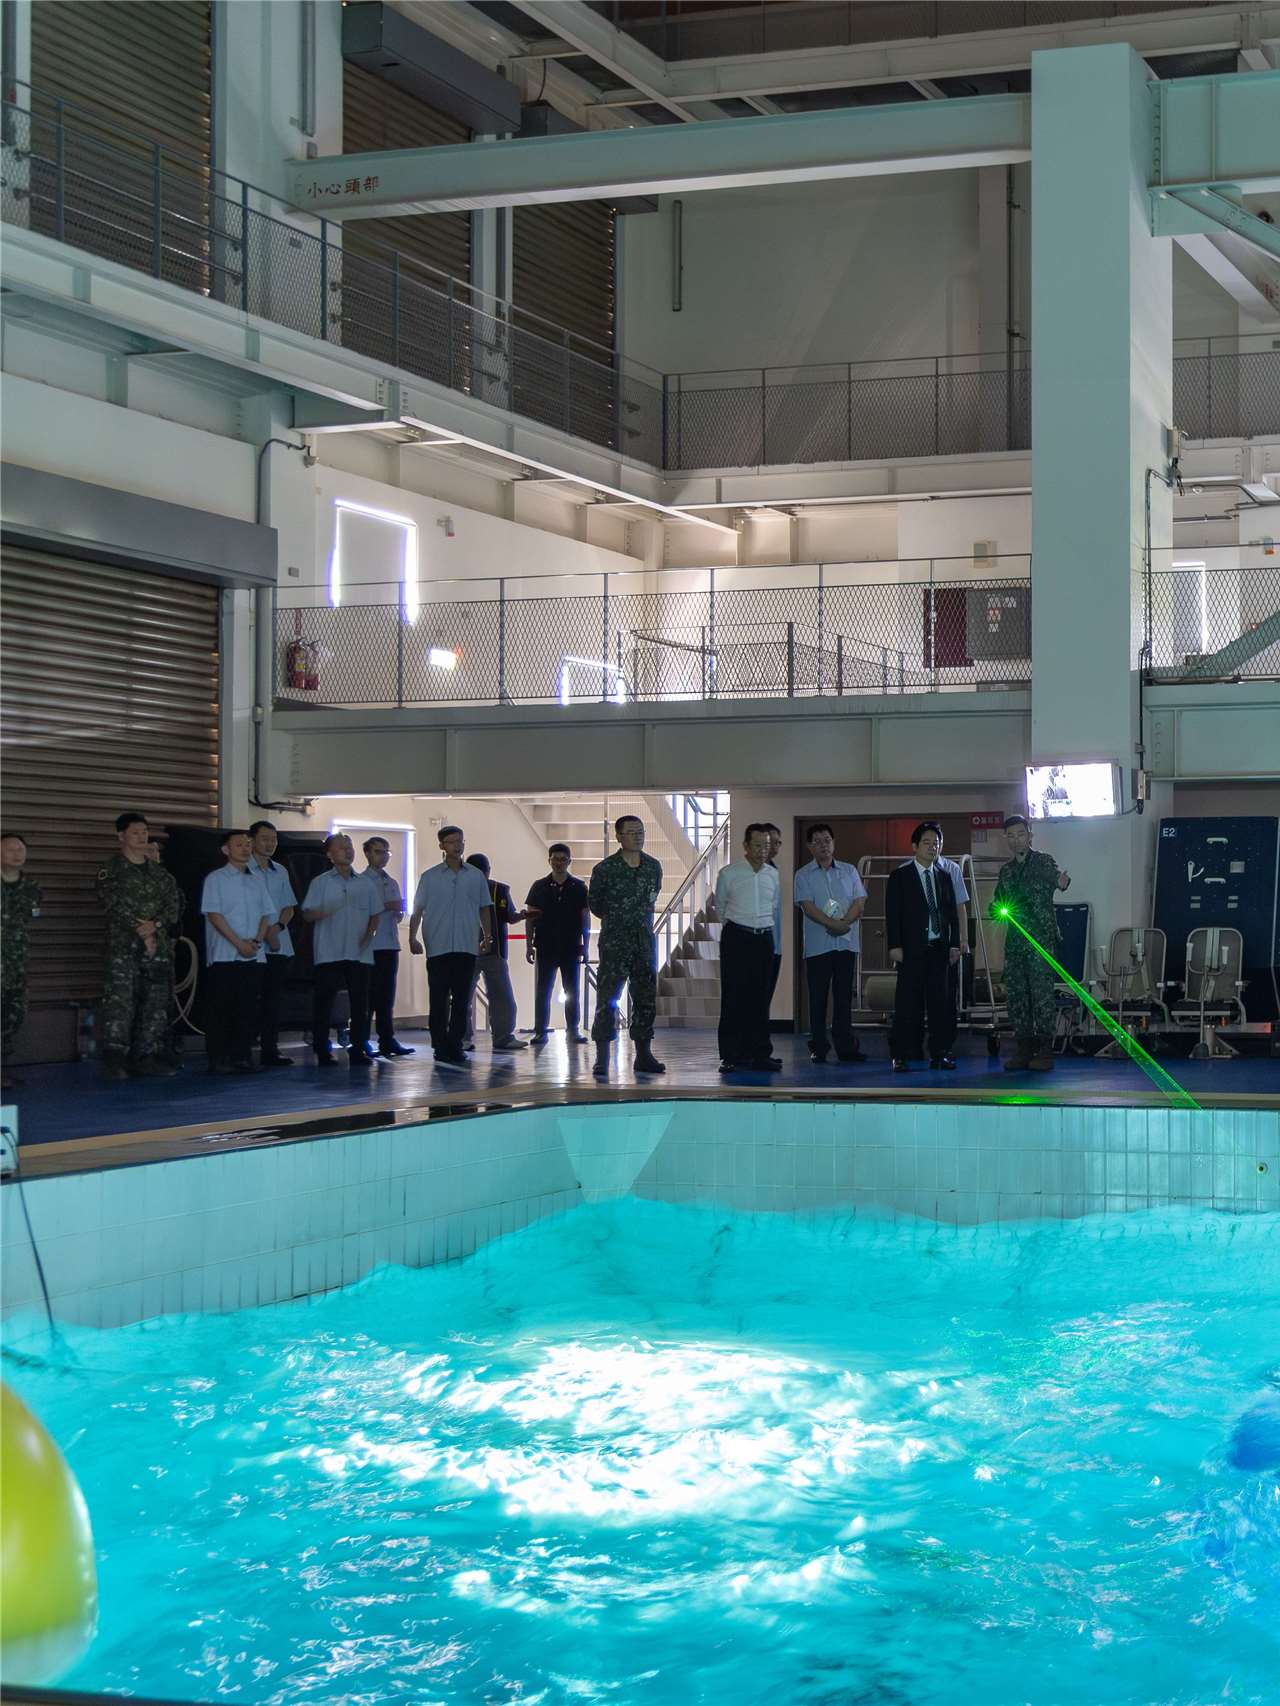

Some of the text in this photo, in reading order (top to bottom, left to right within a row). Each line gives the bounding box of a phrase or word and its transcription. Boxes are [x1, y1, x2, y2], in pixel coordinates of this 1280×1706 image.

[306, 175, 380, 199] 小心頭部
[1162, 827, 1176, 837] E2
